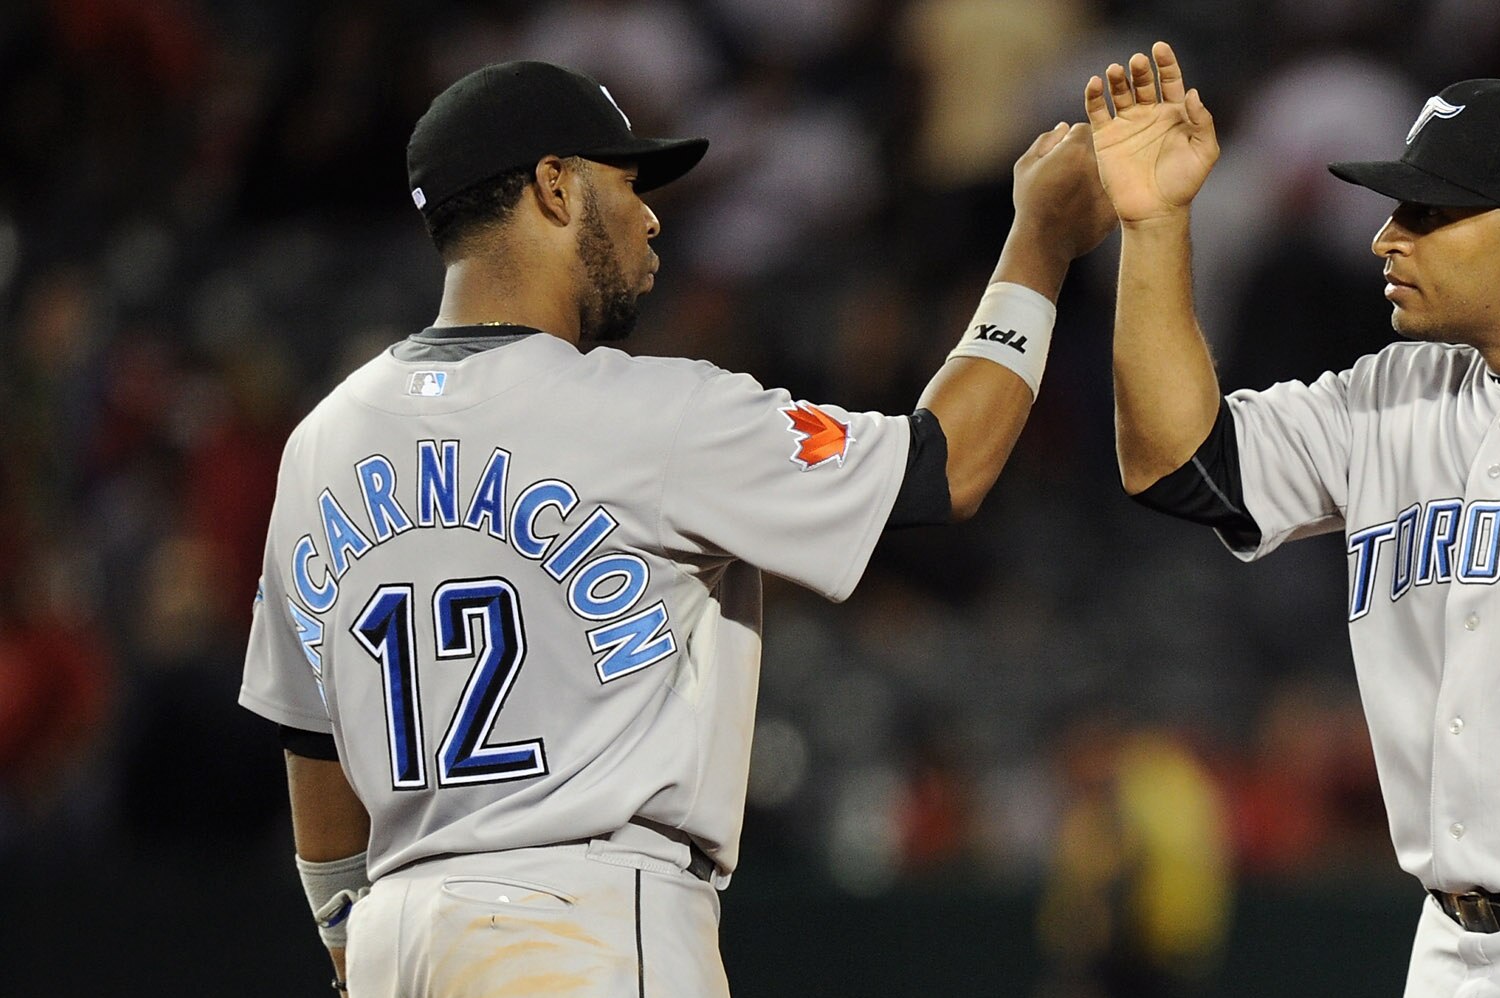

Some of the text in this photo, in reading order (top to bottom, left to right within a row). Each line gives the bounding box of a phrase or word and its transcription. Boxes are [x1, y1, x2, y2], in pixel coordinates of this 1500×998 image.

[974, 324, 1027, 354] TPX
[286, 440, 677, 724] NCARNACION
[350, 577, 549, 791] 12
